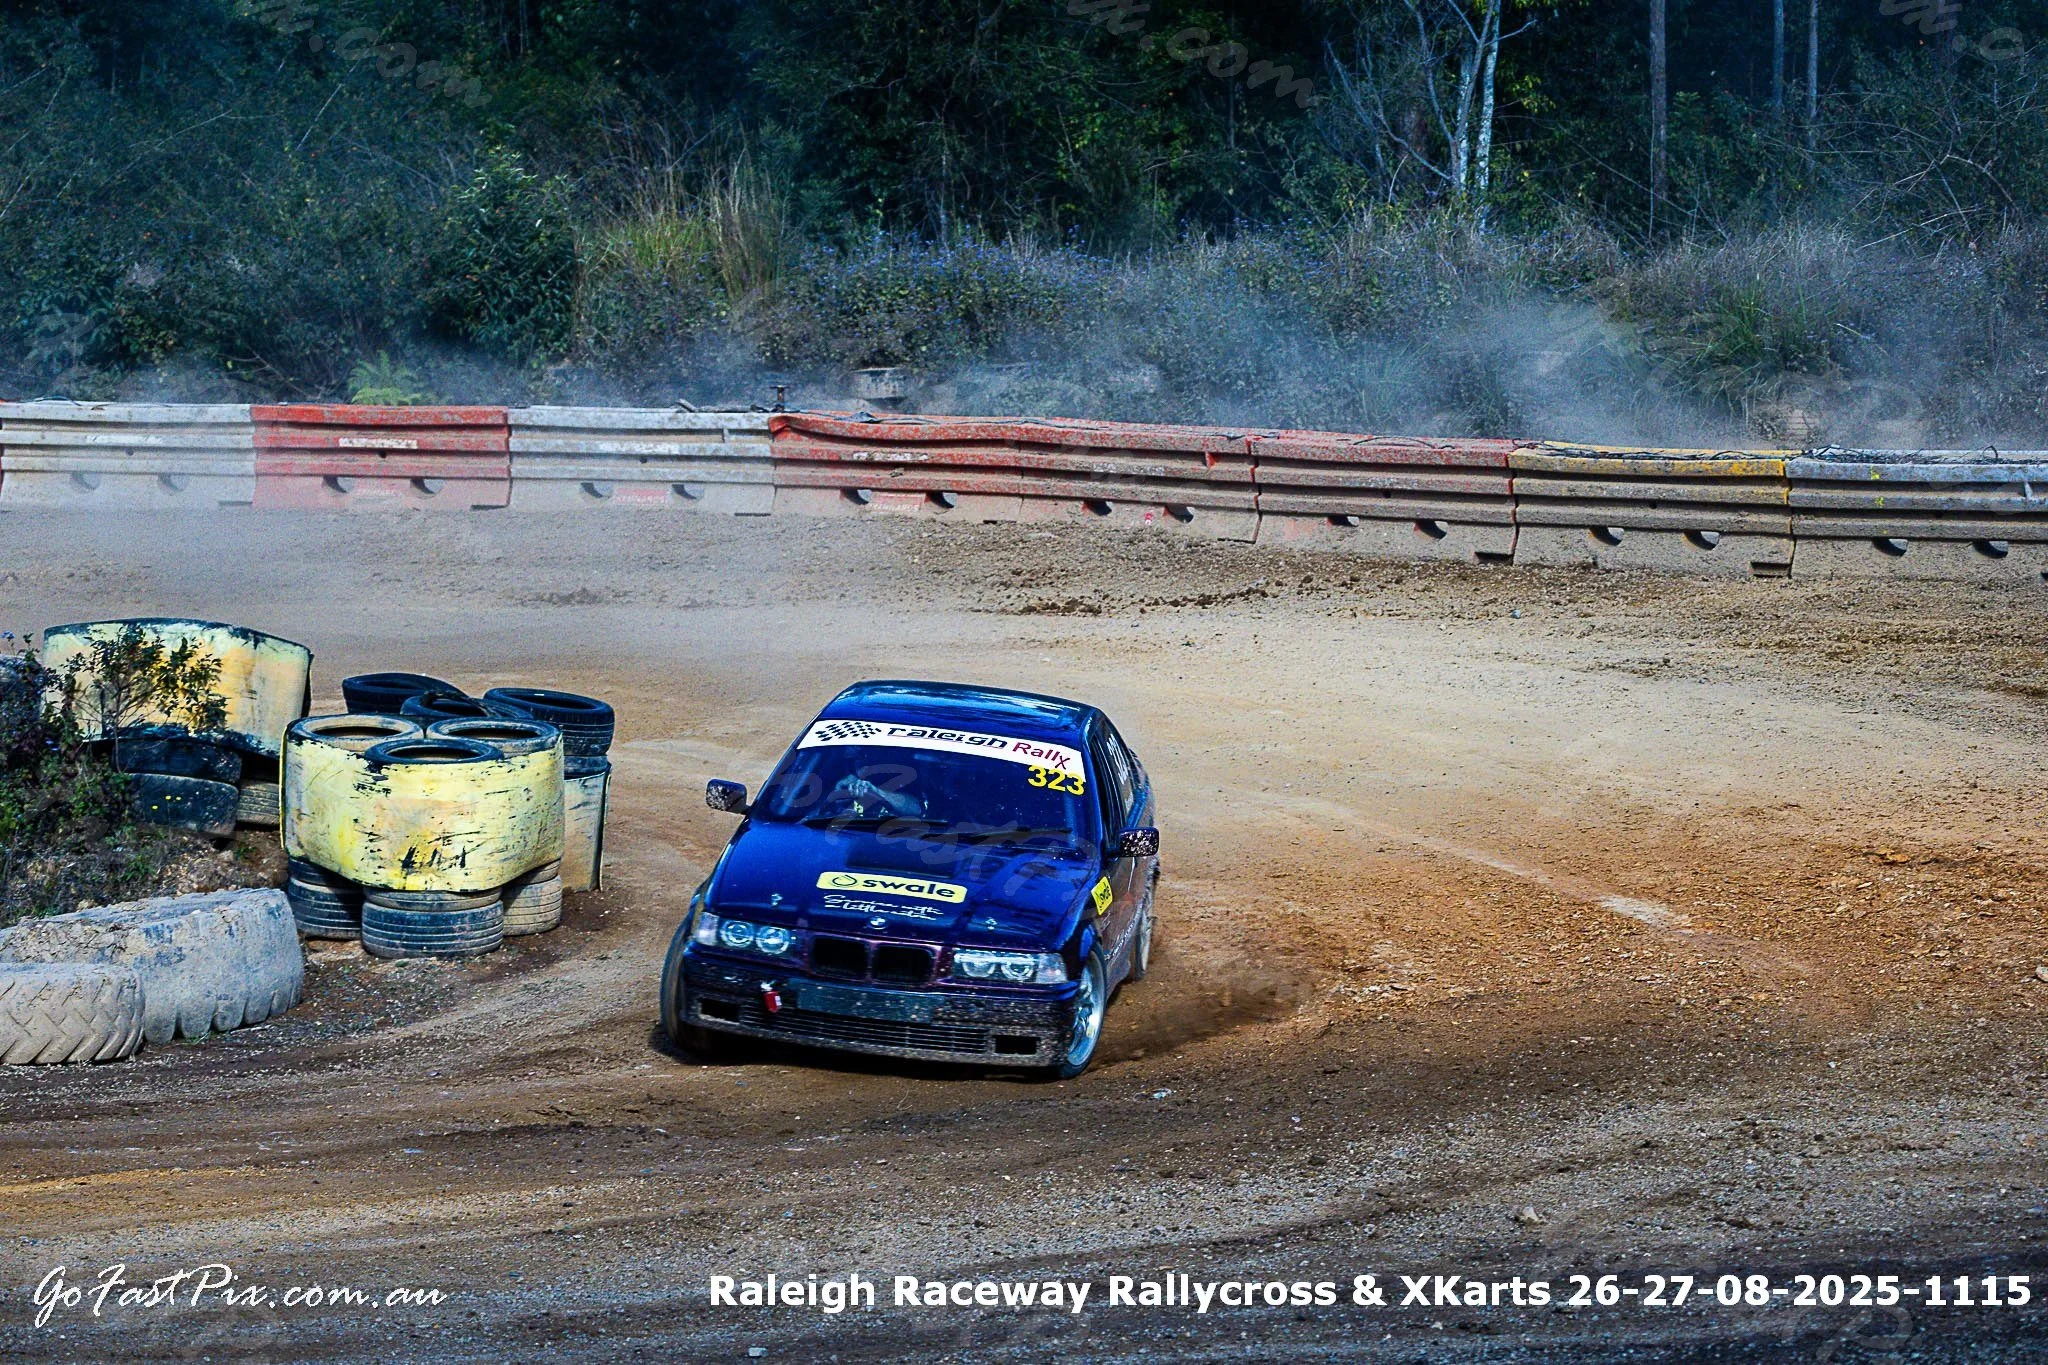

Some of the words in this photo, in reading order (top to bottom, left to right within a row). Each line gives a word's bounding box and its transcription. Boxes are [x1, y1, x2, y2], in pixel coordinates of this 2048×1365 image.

[887, 726, 1008, 749] raleigh
[1027, 765, 1085, 796] 323
[862, 878, 956, 898] swale
